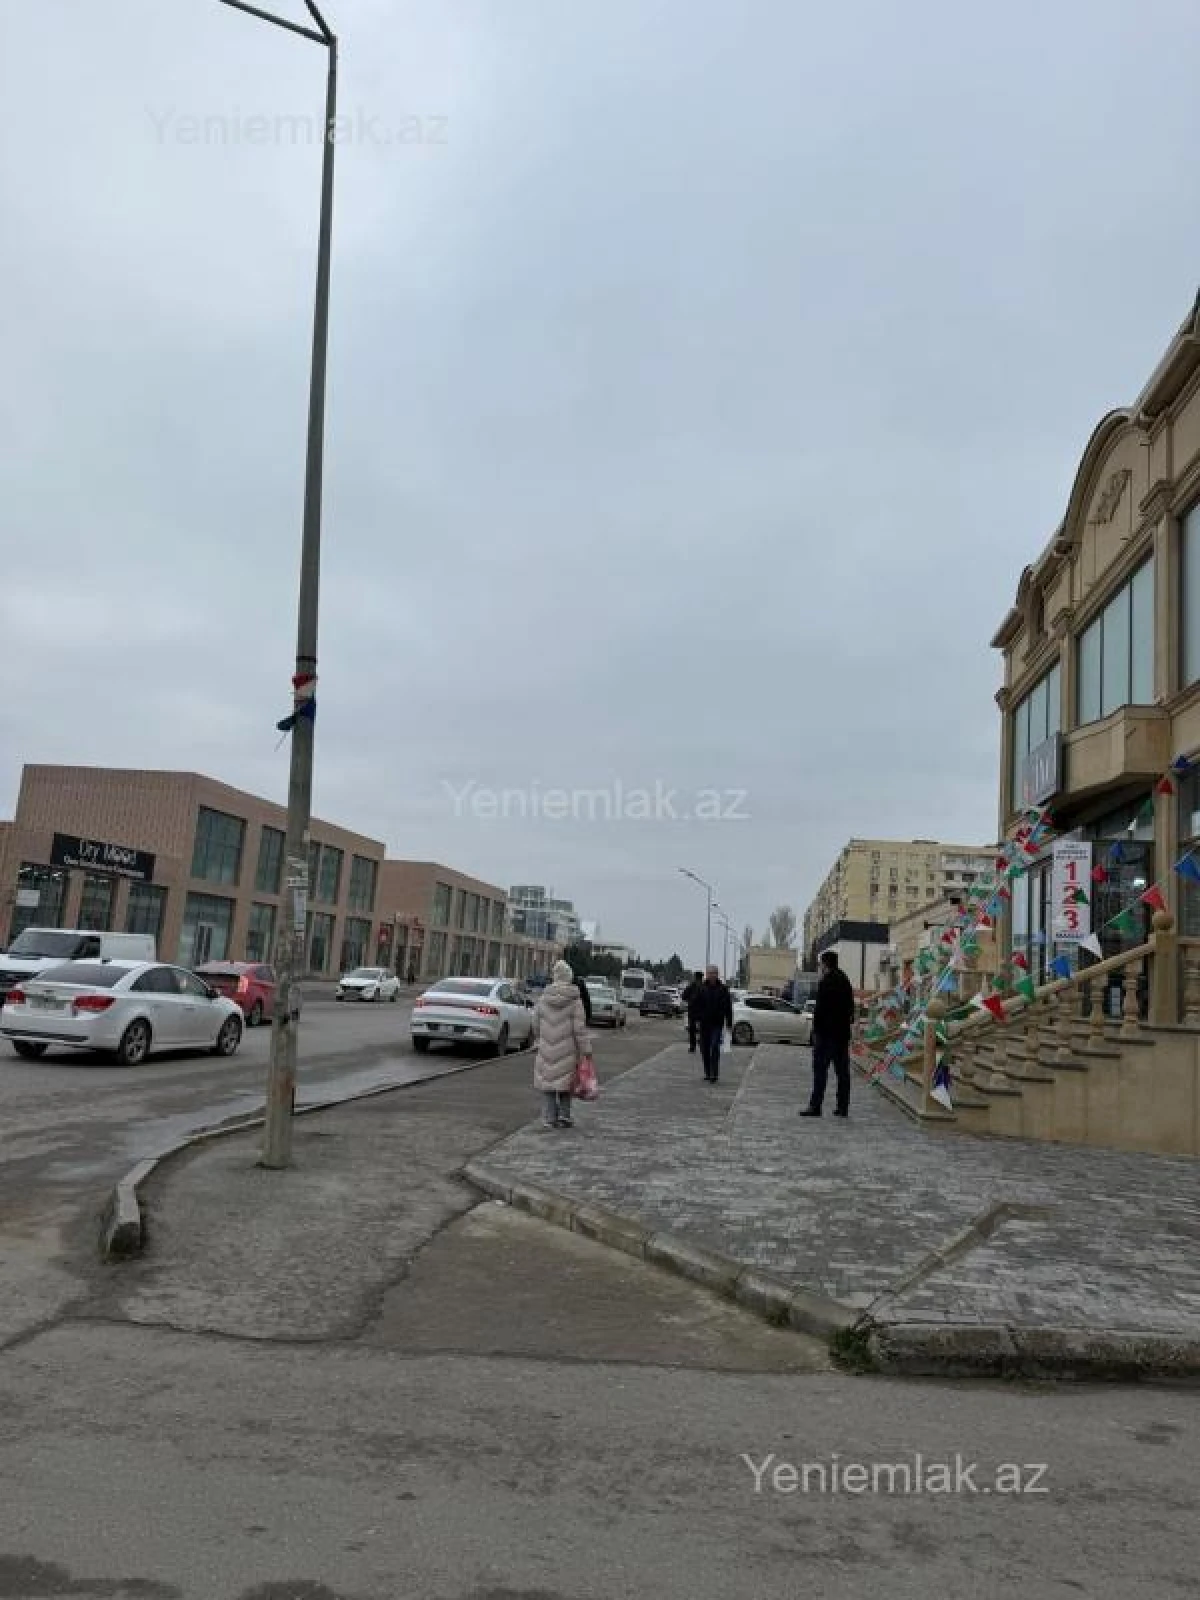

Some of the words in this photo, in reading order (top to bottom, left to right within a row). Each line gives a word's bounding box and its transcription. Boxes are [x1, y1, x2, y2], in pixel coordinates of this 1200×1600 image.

[1064, 862, 1077, 881] 1
[1062, 885, 1078, 905] 2
[1063, 909, 1079, 929] 3
